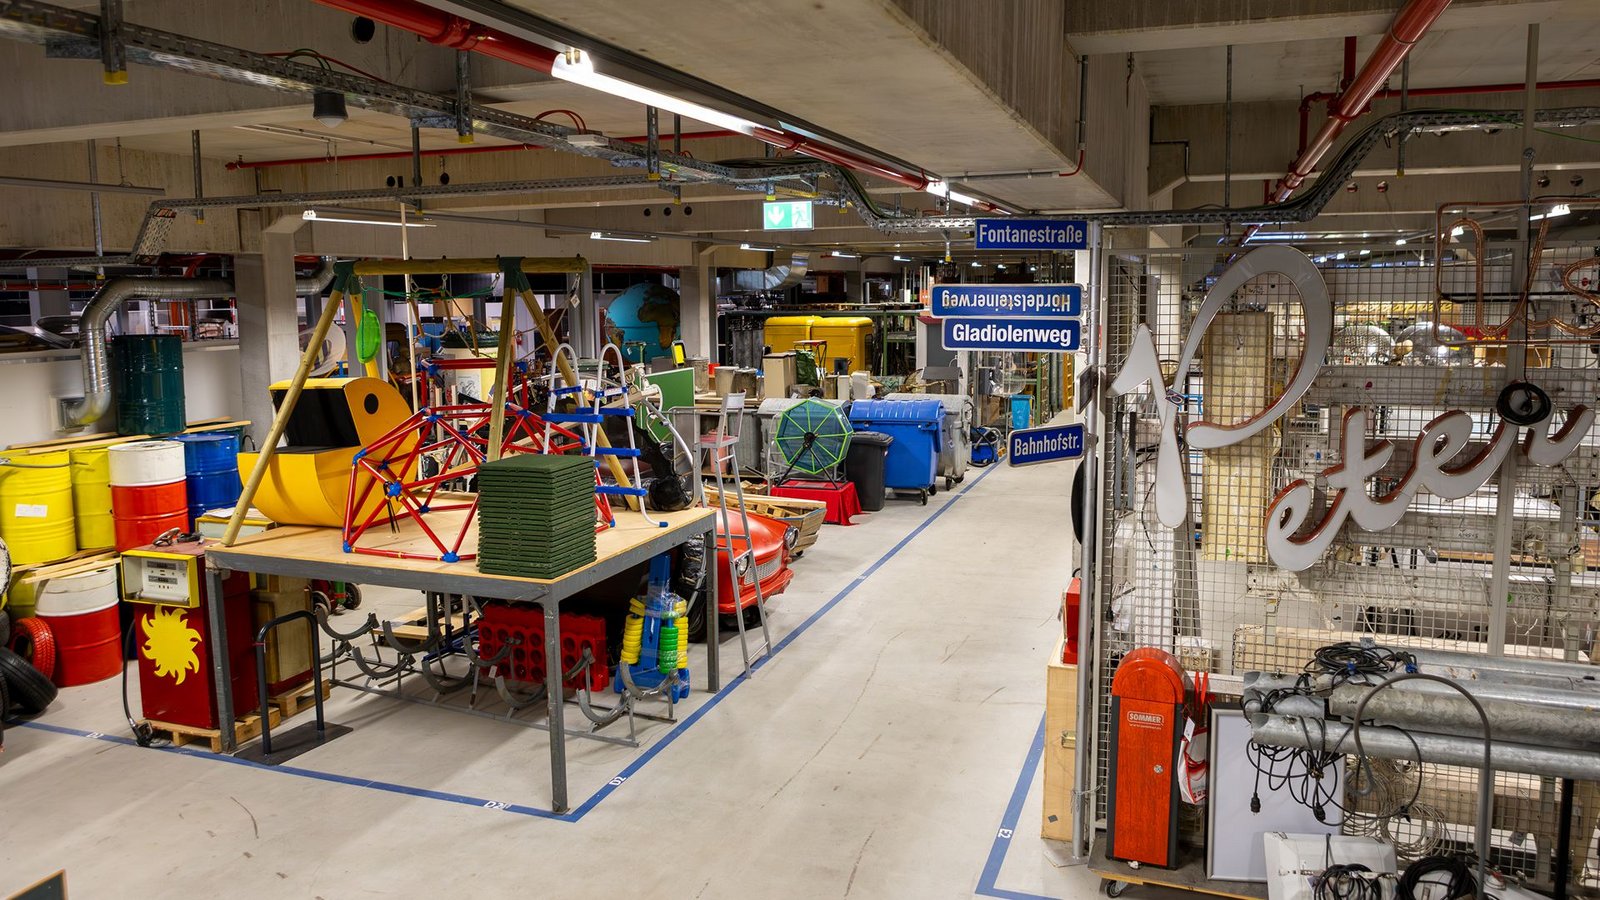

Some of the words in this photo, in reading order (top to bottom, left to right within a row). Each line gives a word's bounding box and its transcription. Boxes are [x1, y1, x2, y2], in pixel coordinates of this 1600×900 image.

[978, 223, 1084, 245] Fontanestraße
[942, 290, 1071, 312] Hördelsteinerweg
[952, 323, 1072, 347] Gladiolenweg
[1013, 434, 1081, 458] Bahnhofstr.
[1129, 713, 1161, 723] SOMMER
[608, 776, 627, 786] D2
